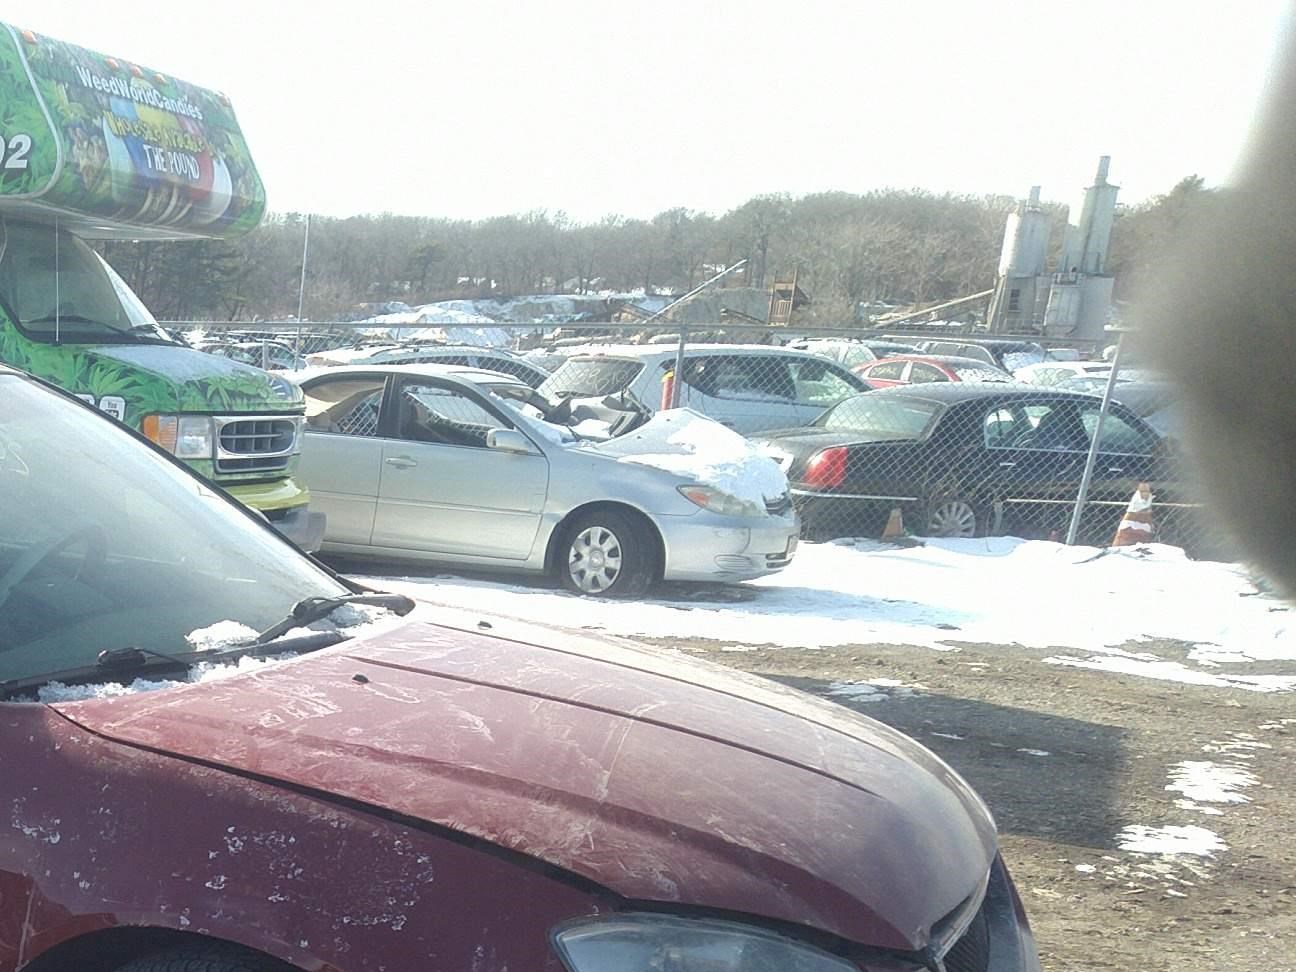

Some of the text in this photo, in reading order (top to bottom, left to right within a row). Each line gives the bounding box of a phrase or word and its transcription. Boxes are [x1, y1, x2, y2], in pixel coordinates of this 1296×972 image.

[76, 65, 204, 120] WeedWorldCandies
[143, 144, 168, 172] THE
[169, 151, 200, 180] POUND
